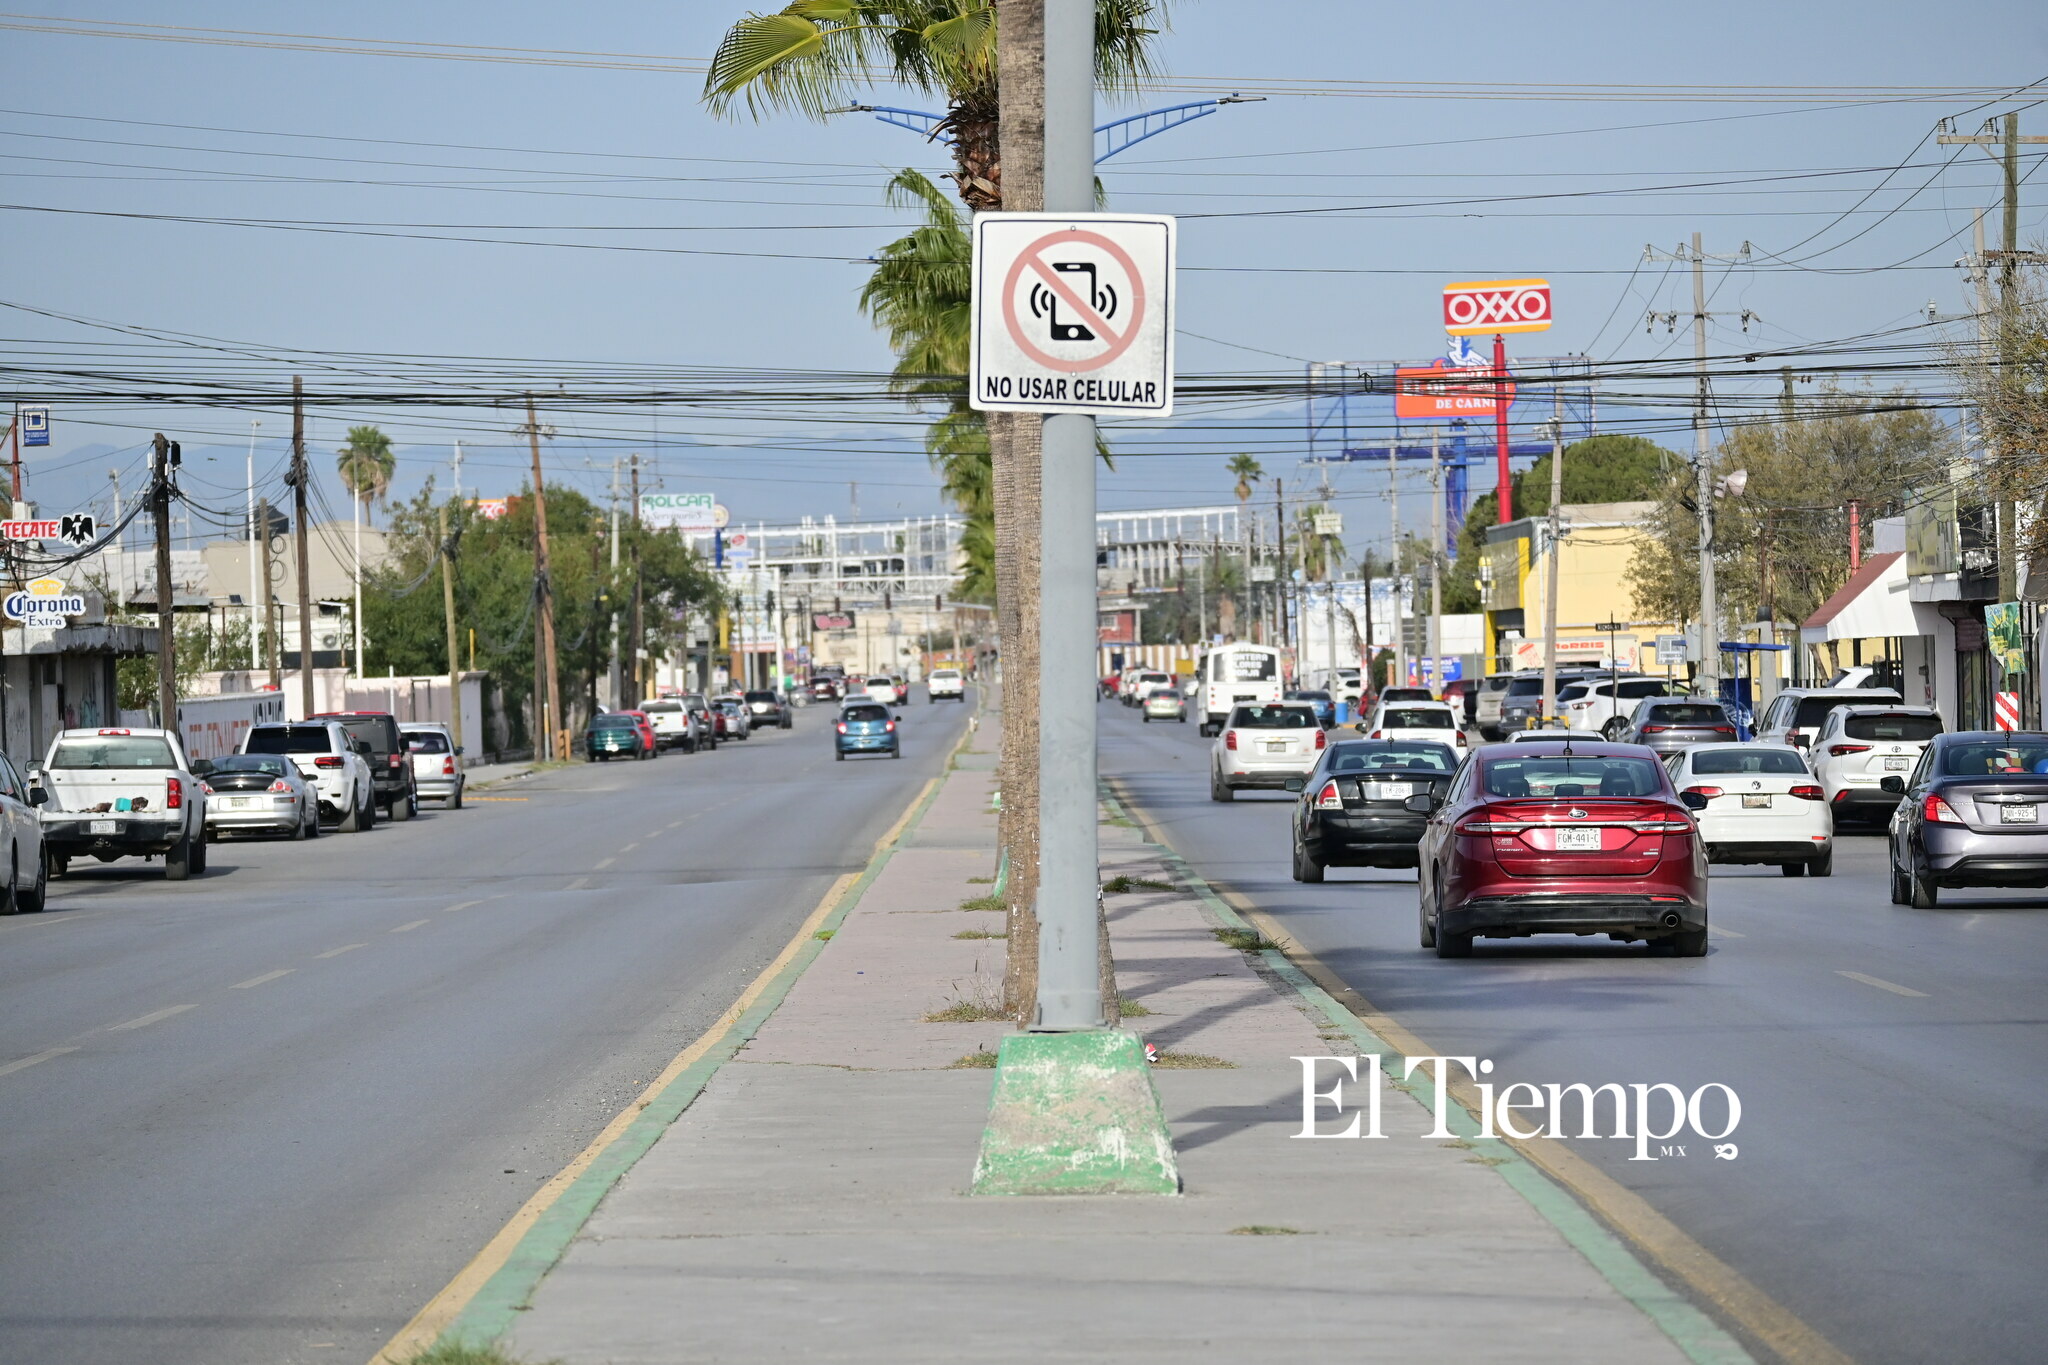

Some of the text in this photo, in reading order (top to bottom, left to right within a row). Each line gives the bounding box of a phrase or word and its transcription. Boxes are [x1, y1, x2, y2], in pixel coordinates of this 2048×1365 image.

[1448, 289, 1547, 324] OXXO
[986, 376, 1156, 403] NO USAR CELULAR
[1435, 399, 1453, 409] DE
[642, 495, 712, 510] ROLCAR
[2, 521, 58, 538] TECATE
[6, 595, 83, 617] Corona
[28, 614, 62, 627] Extra
